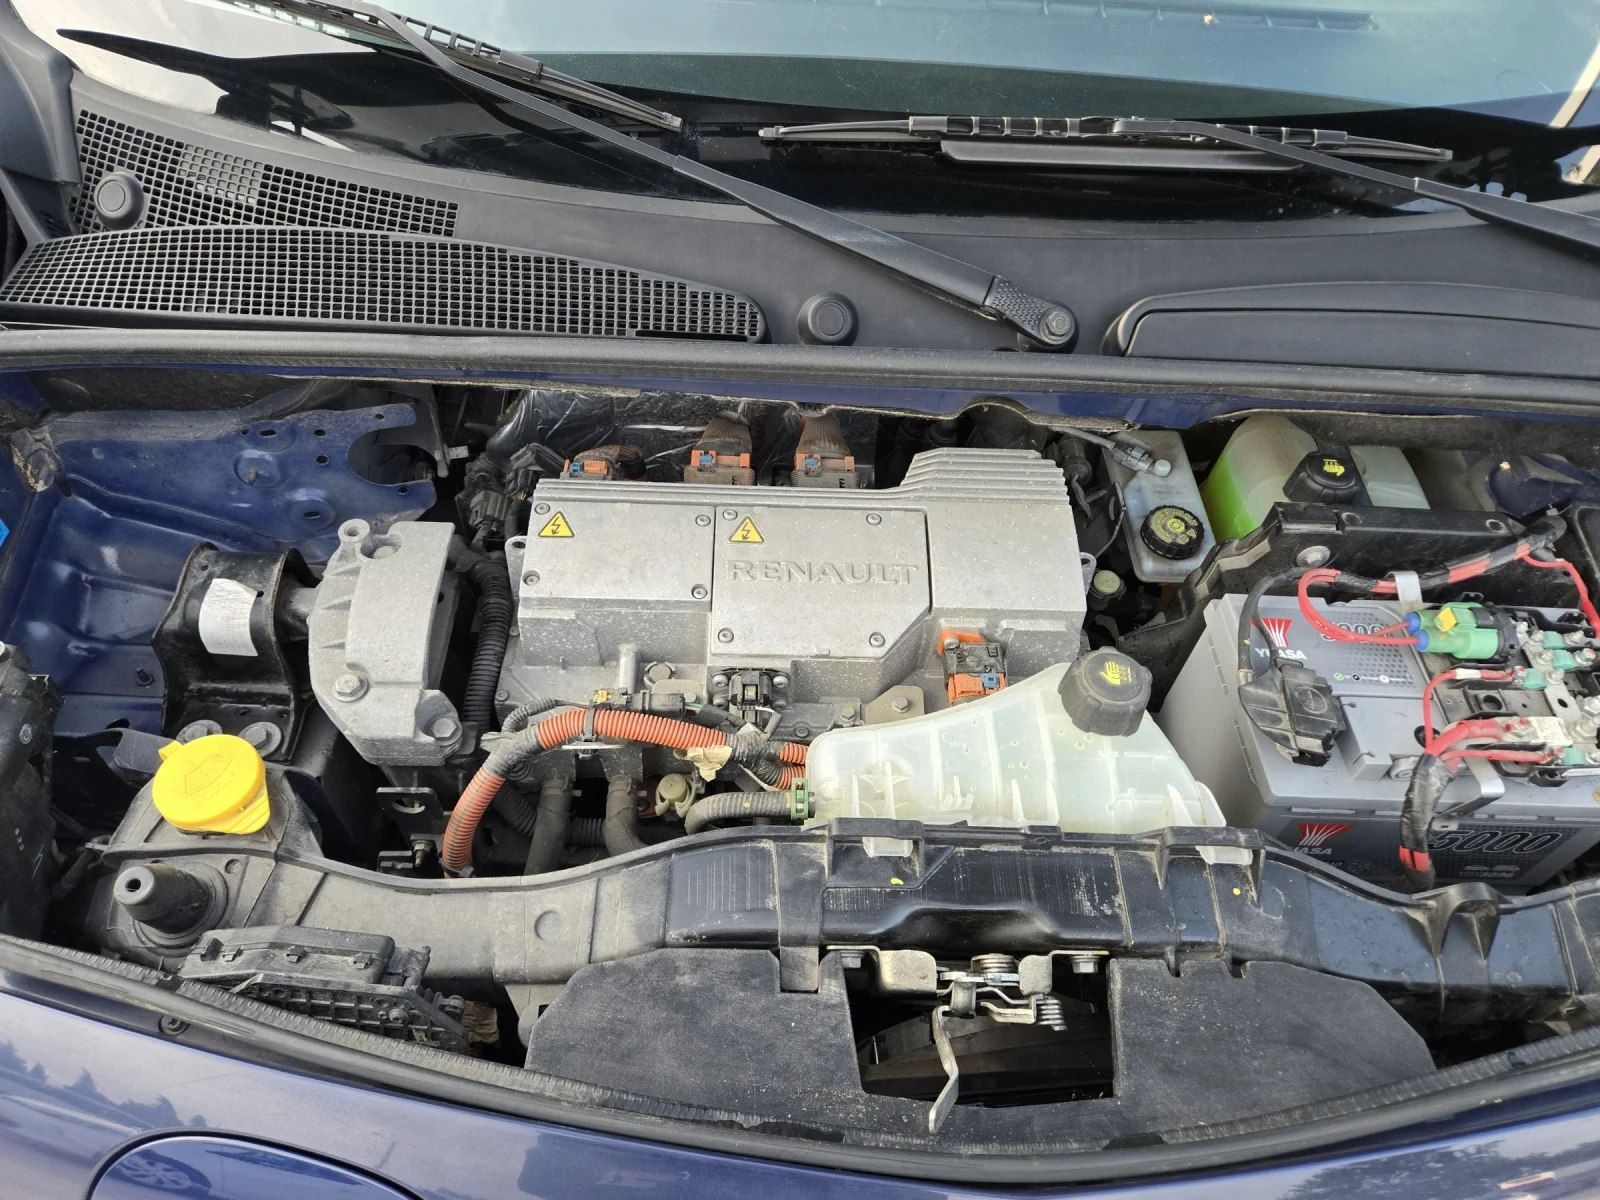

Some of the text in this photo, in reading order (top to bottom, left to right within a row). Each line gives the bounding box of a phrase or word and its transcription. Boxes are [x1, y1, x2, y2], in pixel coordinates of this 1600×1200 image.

[725, 559, 918, 585] RENAULT
[1292, 846, 1332, 855] ASA
[1428, 830, 1562, 853] 5000
